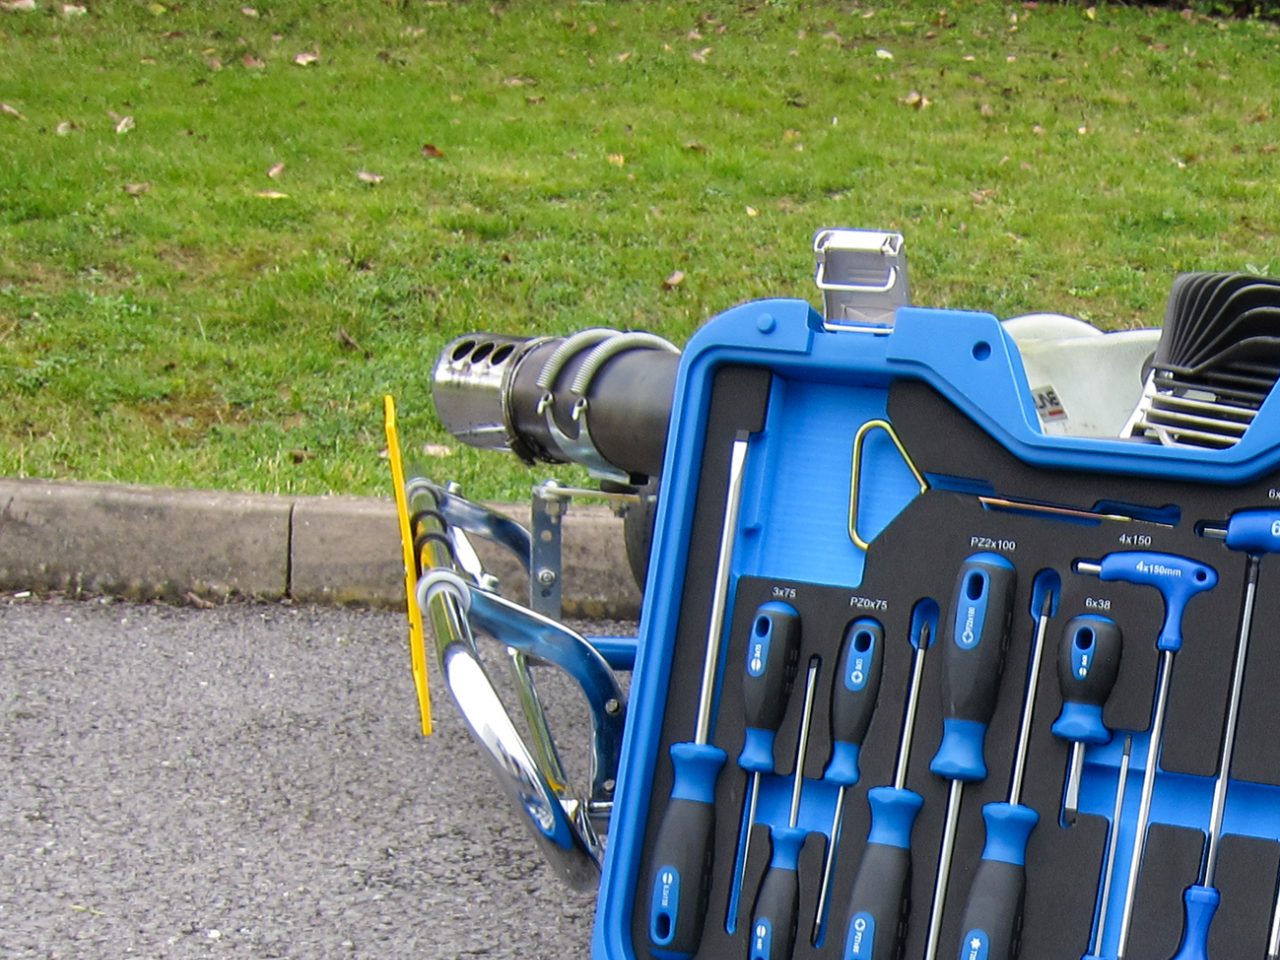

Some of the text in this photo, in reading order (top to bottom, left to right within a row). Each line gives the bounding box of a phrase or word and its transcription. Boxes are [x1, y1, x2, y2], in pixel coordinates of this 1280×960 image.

[970, 536, 1016, 551] PZ2x100
[1119, 533, 1152, 546] 4x150
[1135, 557, 1182, 577] 4x150mm
[772, 586, 796, 598] 3x75
[850, 596, 888, 610] PZ0x75
[1085, 597, 1111, 610] 6x38
